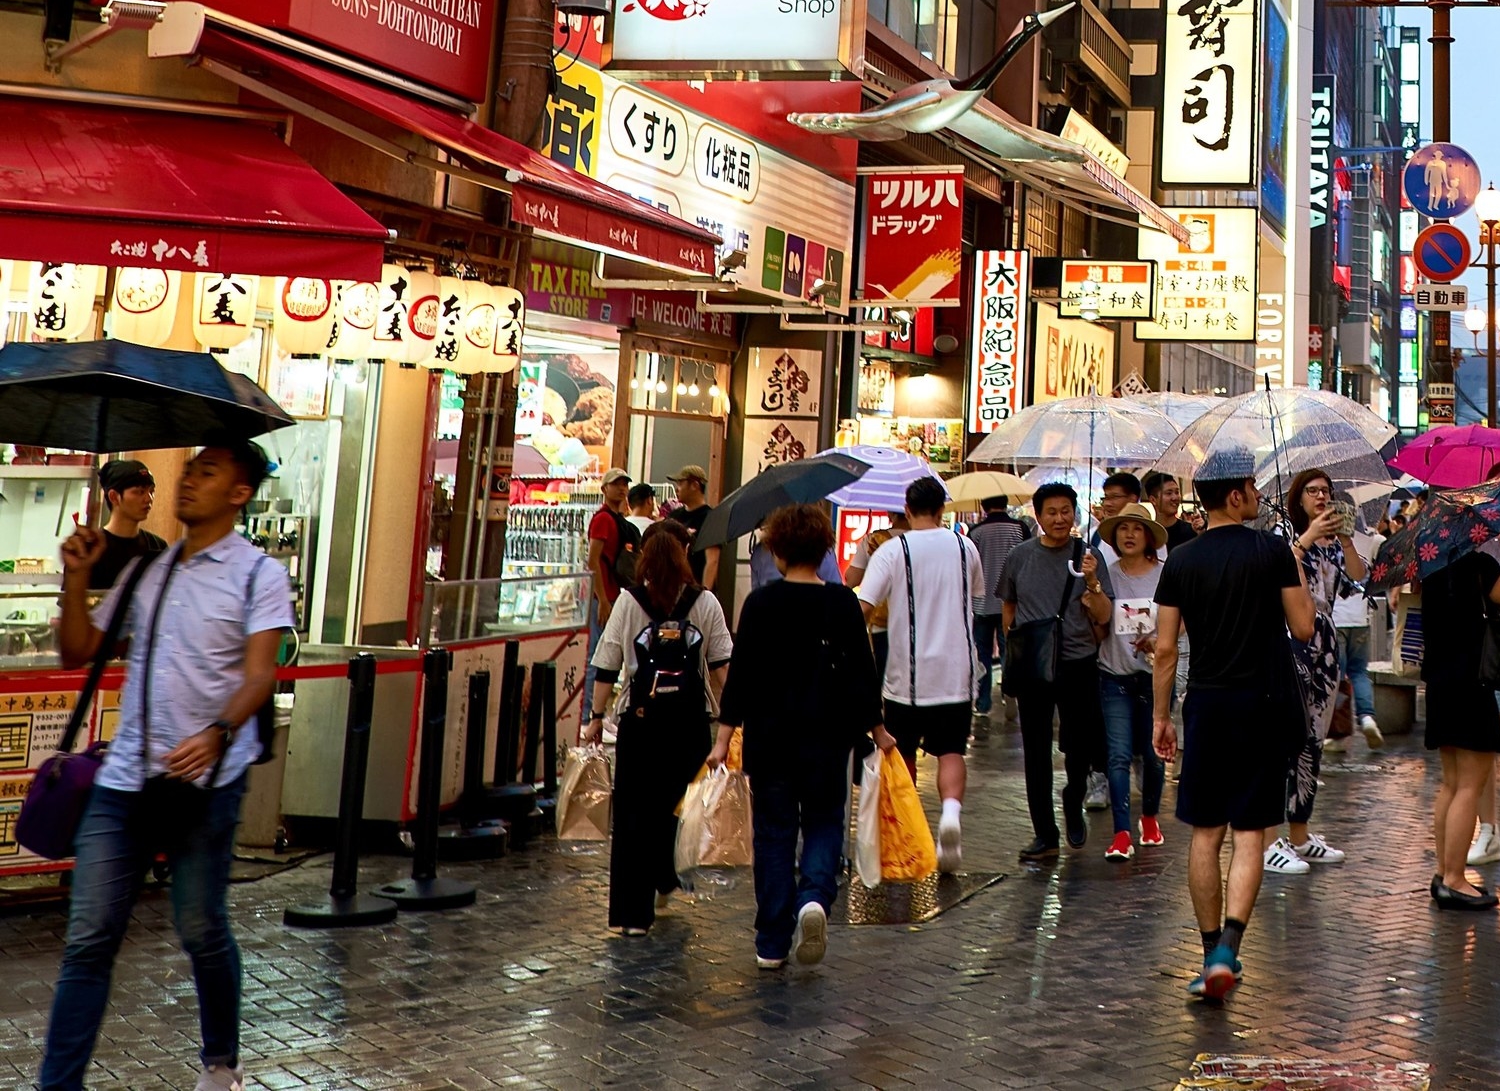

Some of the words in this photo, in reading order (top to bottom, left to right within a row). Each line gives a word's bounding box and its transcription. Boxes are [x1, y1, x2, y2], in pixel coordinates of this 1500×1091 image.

[623, 102, 677, 160] くすり
[706, 136, 751, 192] 化粧品
[1310, 87, 1331, 229] TSUTAYA
[873, 180, 960, 208] ツルハ
[871, 214, 943, 235] ドラッグ
[110, 239, 148, 258] たこ焼
[531, 263, 568, 296] TAX
[550, 297, 590, 318] STORE
[1417, 290, 1466, 306] 自動車
[652, 300, 705, 331] WELCOME
[710, 311, 732, 338] 欢迎
[982, 263, 1016, 421] 大阪紀念品
[760, 366, 784, 412] まつり
